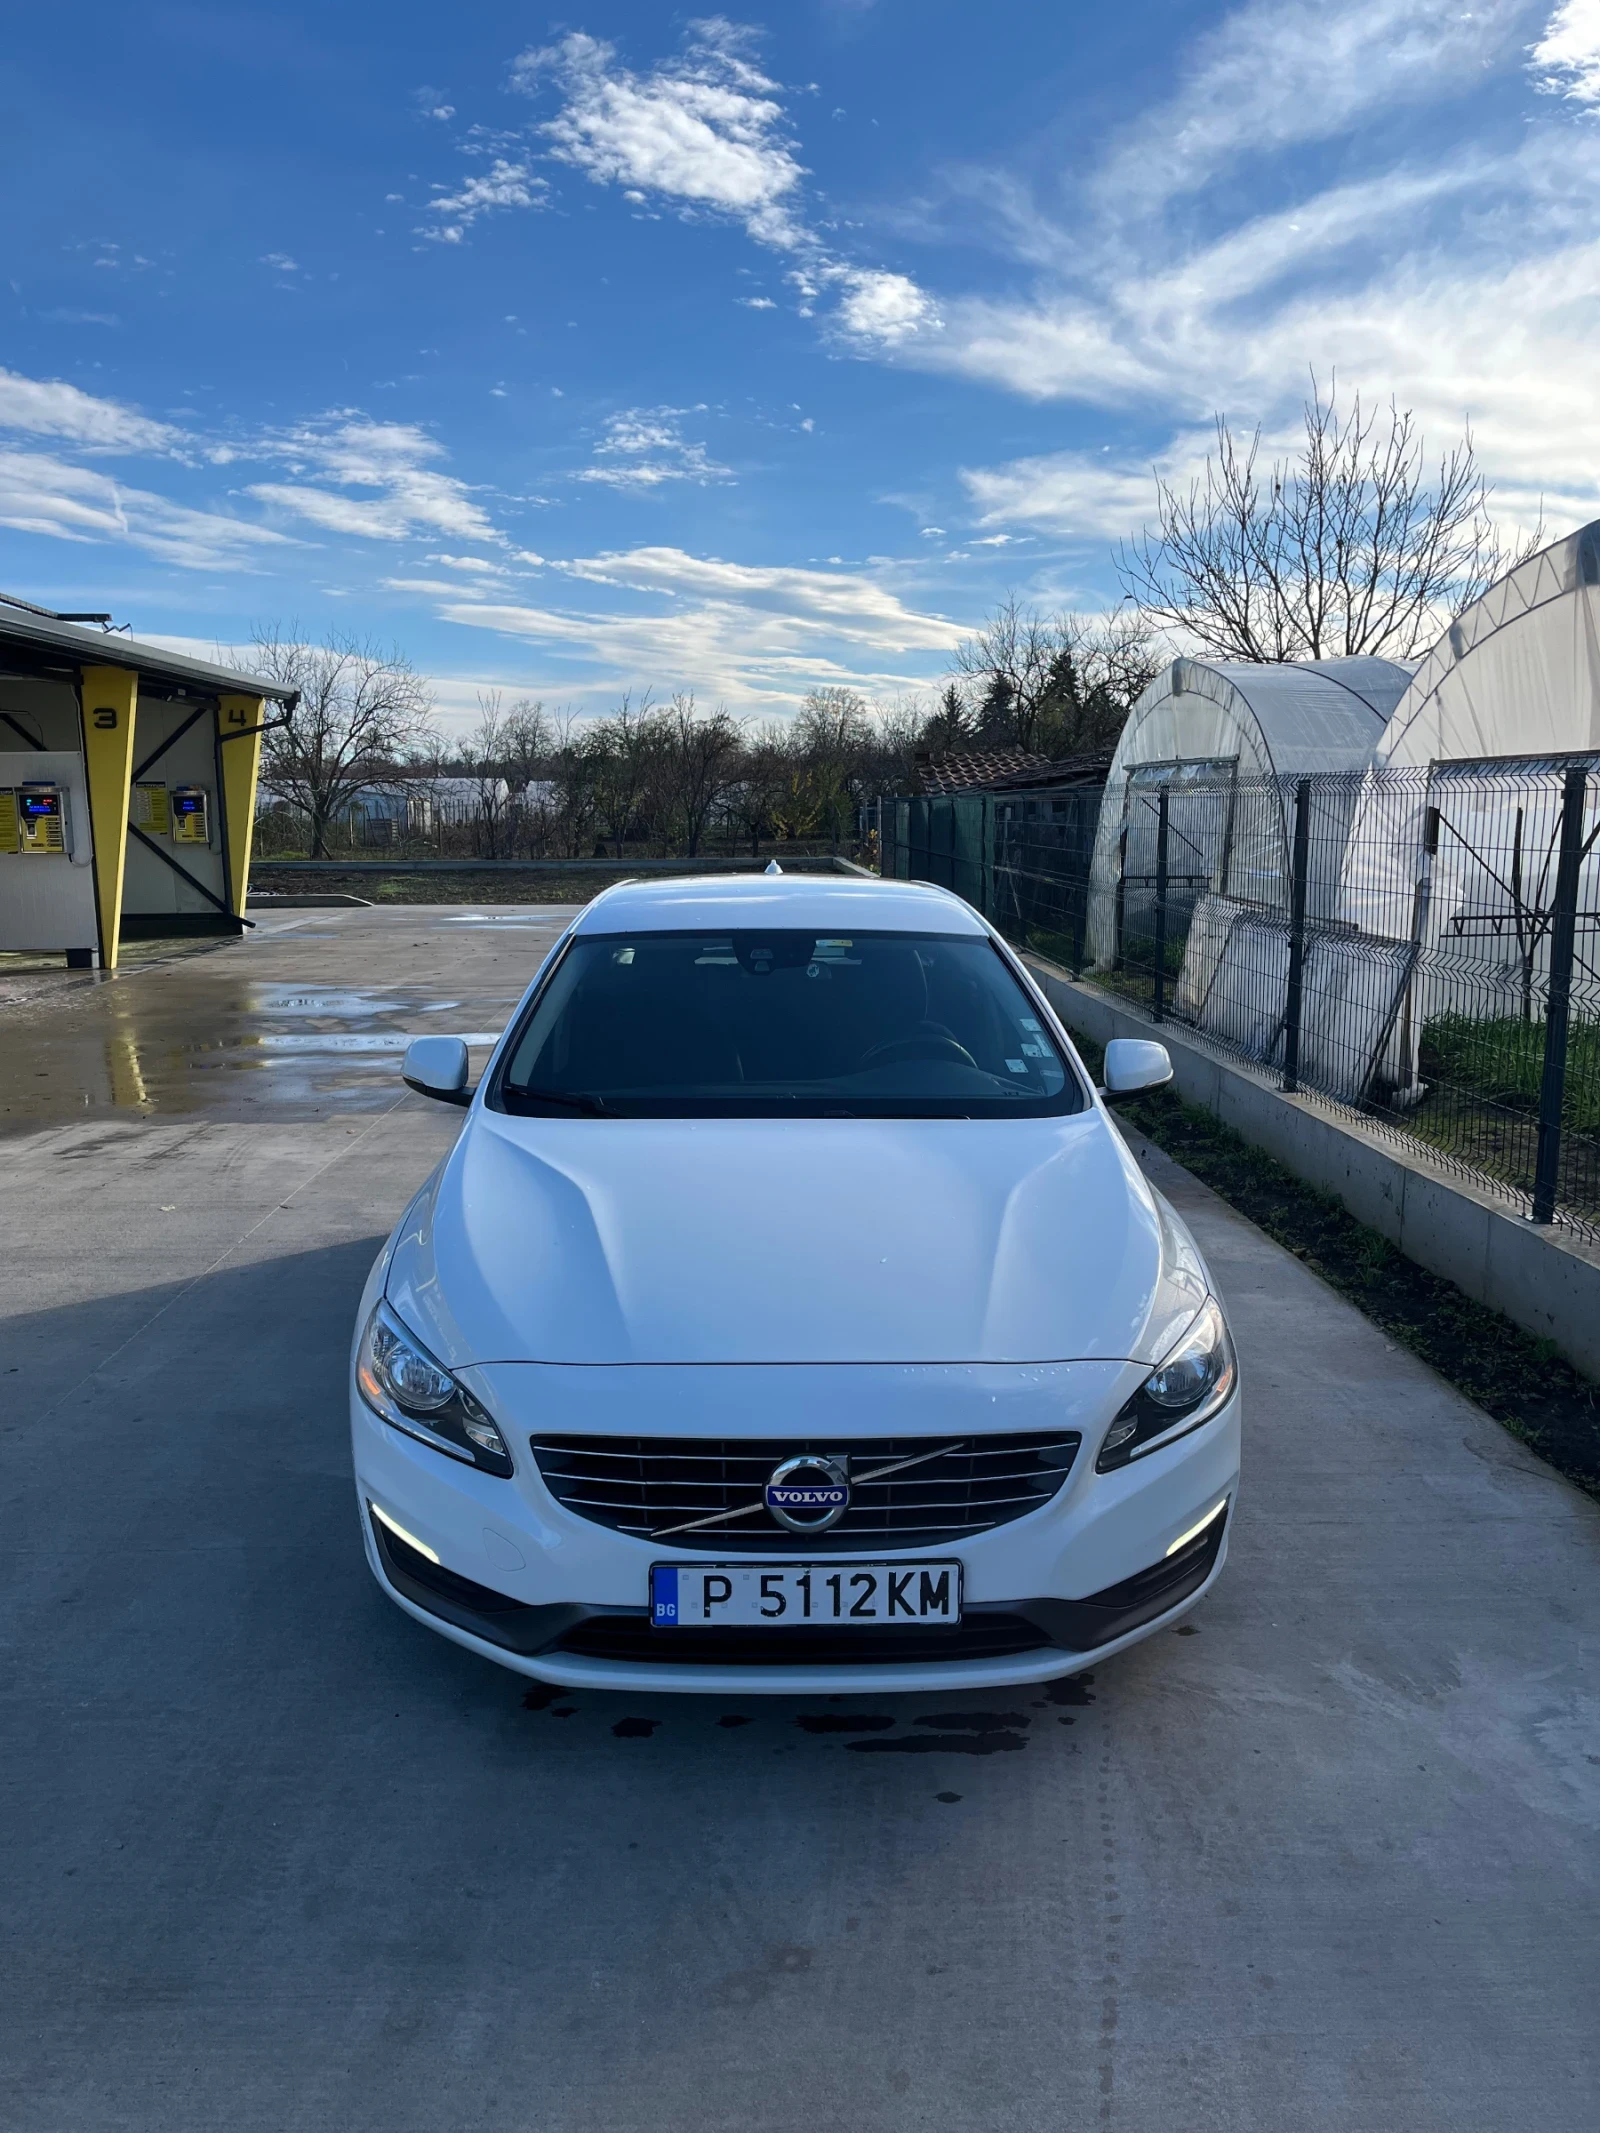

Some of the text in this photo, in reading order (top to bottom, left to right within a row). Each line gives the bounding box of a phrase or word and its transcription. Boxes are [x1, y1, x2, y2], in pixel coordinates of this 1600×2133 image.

[93, 707, 117, 729] 3
[228, 709, 246, 726] 4
[772, 1490, 843, 1503] VOLVO
[703, 1575, 732, 1618] P
[656, 1603, 676, 1617] BG
